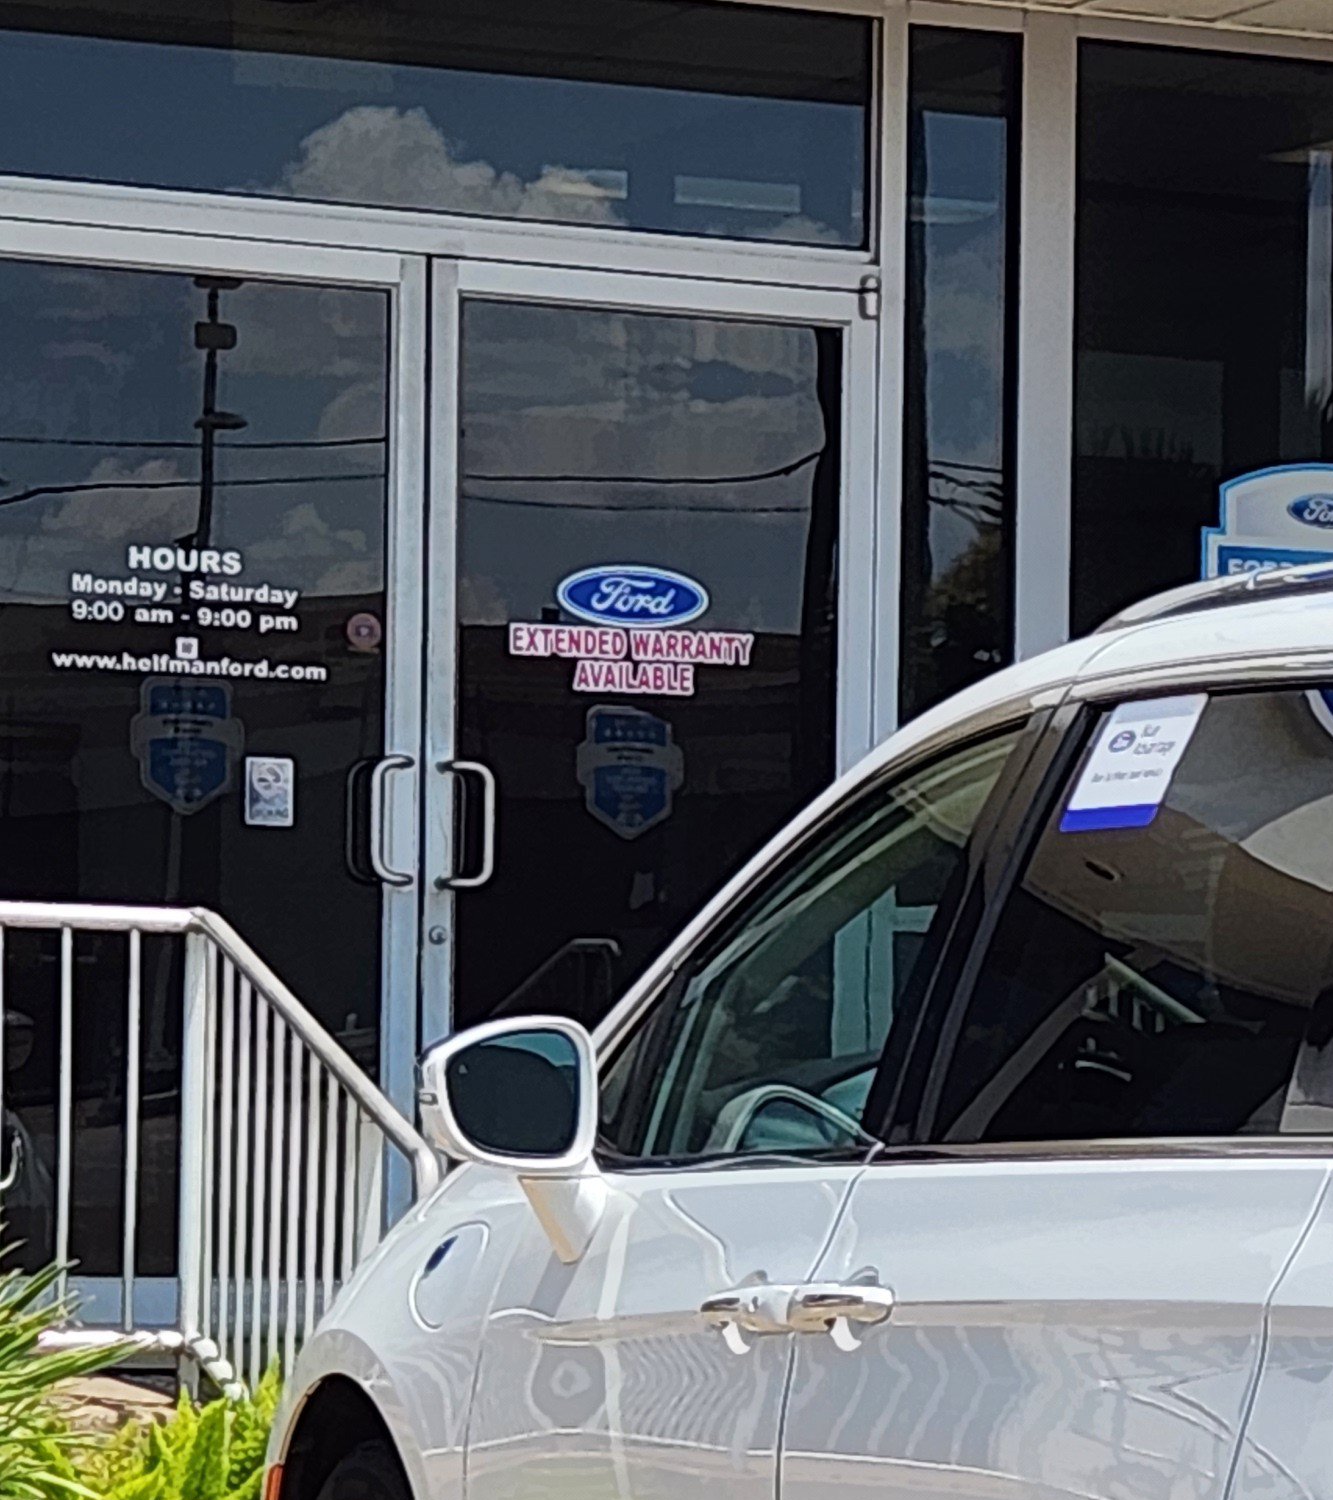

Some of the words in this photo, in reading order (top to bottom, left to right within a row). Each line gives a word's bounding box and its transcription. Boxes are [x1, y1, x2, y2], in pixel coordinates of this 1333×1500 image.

[128, 545, 242, 576] HOURS
[71, 572, 167, 602] Monday
[188, 579, 299, 609] Saturday
[590, 576, 676, 615] Ford
[71, 600, 125, 622] 9:00
[134, 607, 174, 624] am
[197, 607, 252, 628] 9:00
[259, 614, 299, 634] pm
[511, 625, 626, 657] EXTENDED
[631, 631, 754, 665] WARRANTY
[51, 652, 328, 681] www.helfmanford.com
[573, 661, 695, 694] AVAILABLE
